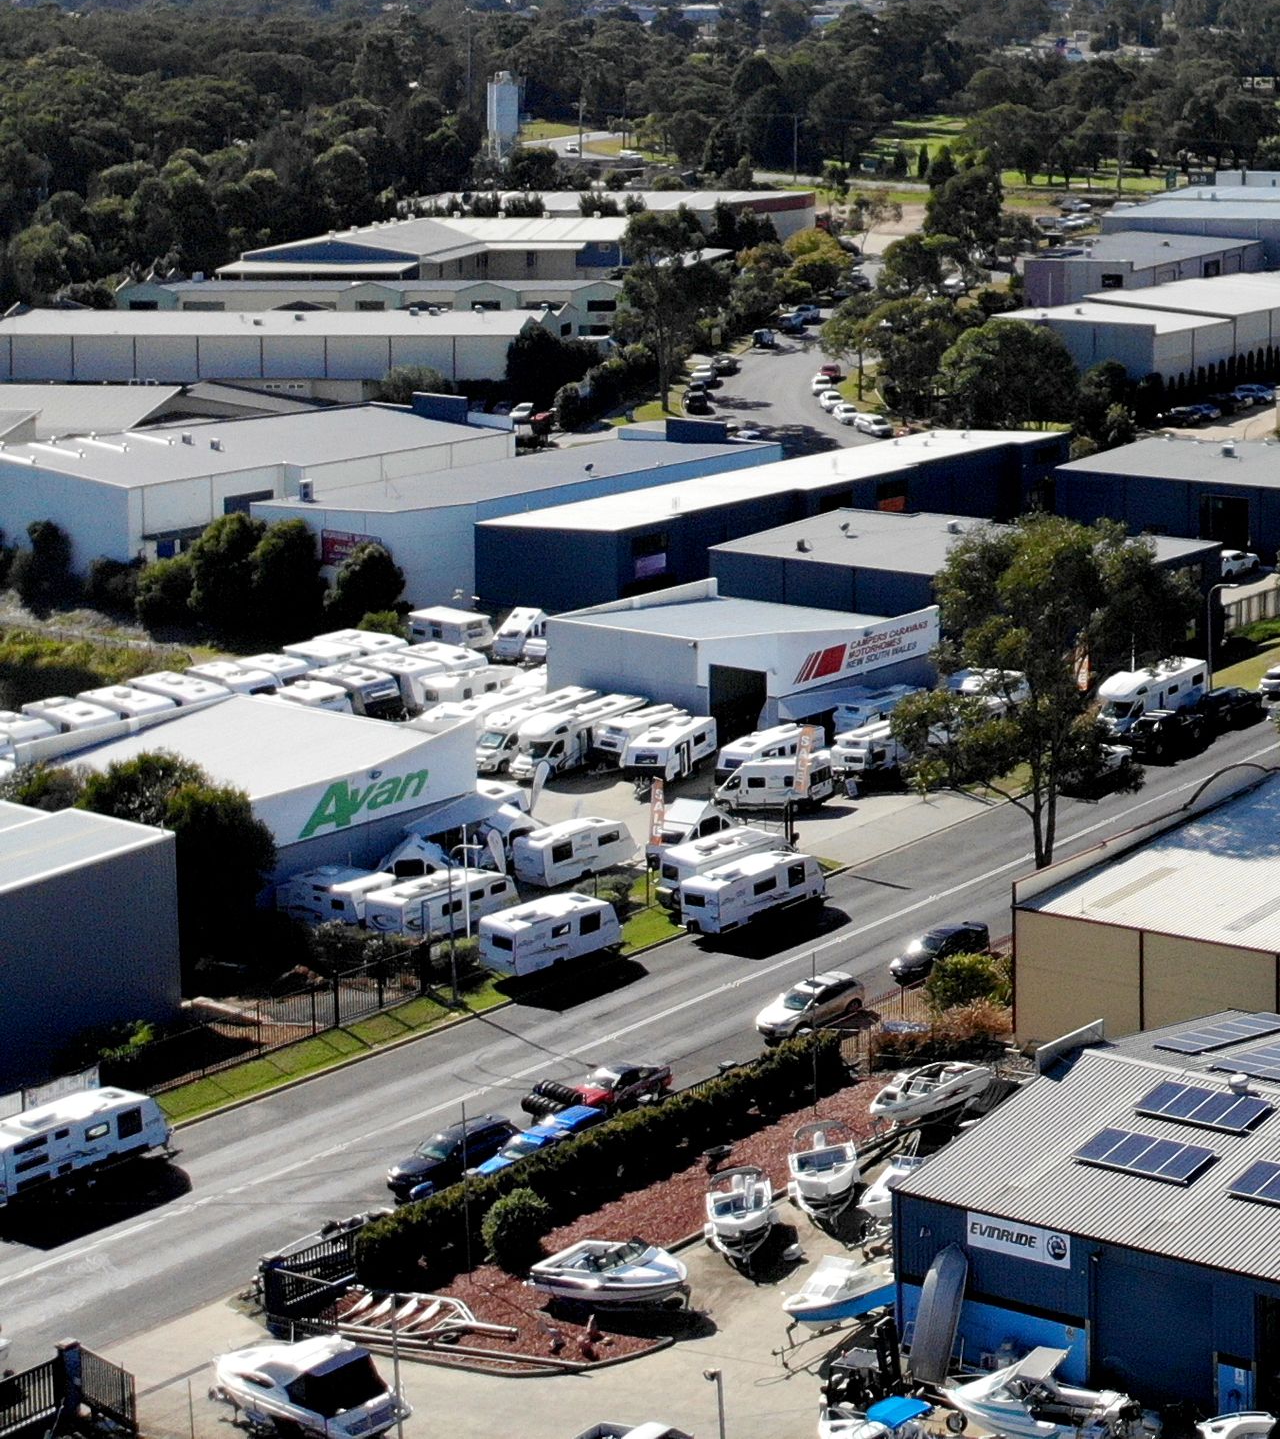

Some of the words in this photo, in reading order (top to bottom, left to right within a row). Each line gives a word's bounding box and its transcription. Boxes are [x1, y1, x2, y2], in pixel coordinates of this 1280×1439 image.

[848, 637, 902, 659] MOTORHOMES
[850, 631, 888, 649] CAMPERS
[889, 620, 929, 637] CARAVANS
[846, 656, 863, 669] NEW
[865, 649, 890, 665] SOUTH
[891, 641, 917, 657] WALES
[796, 735, 810, 784] SALE
[298, 768, 429, 840] Avan
[653, 788, 664, 837] SALE
[969, 1222, 1038, 1249] EVINRUDE
